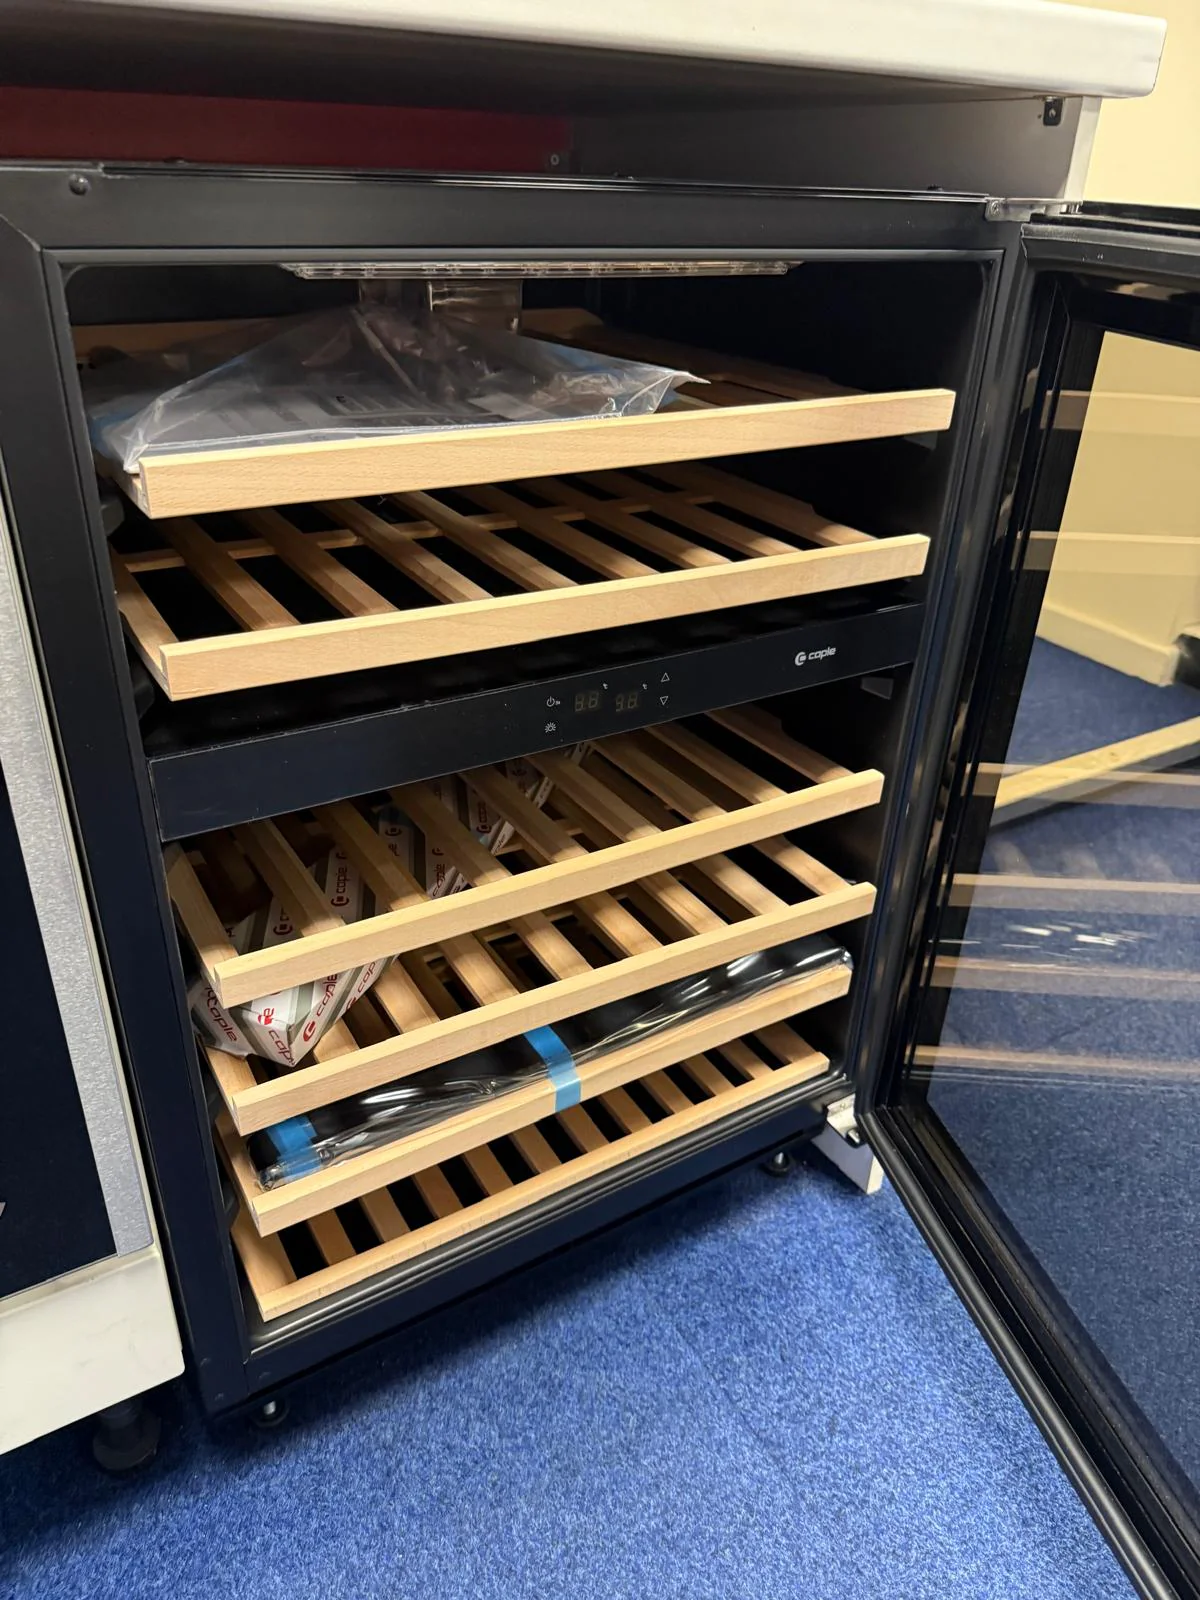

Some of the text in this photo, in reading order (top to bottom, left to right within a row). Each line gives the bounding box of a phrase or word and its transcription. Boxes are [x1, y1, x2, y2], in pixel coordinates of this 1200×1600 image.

[808, 646, 837, 661] caple
[357, 961, 376, 994] cap
[268, 1029, 296, 1066] cap
